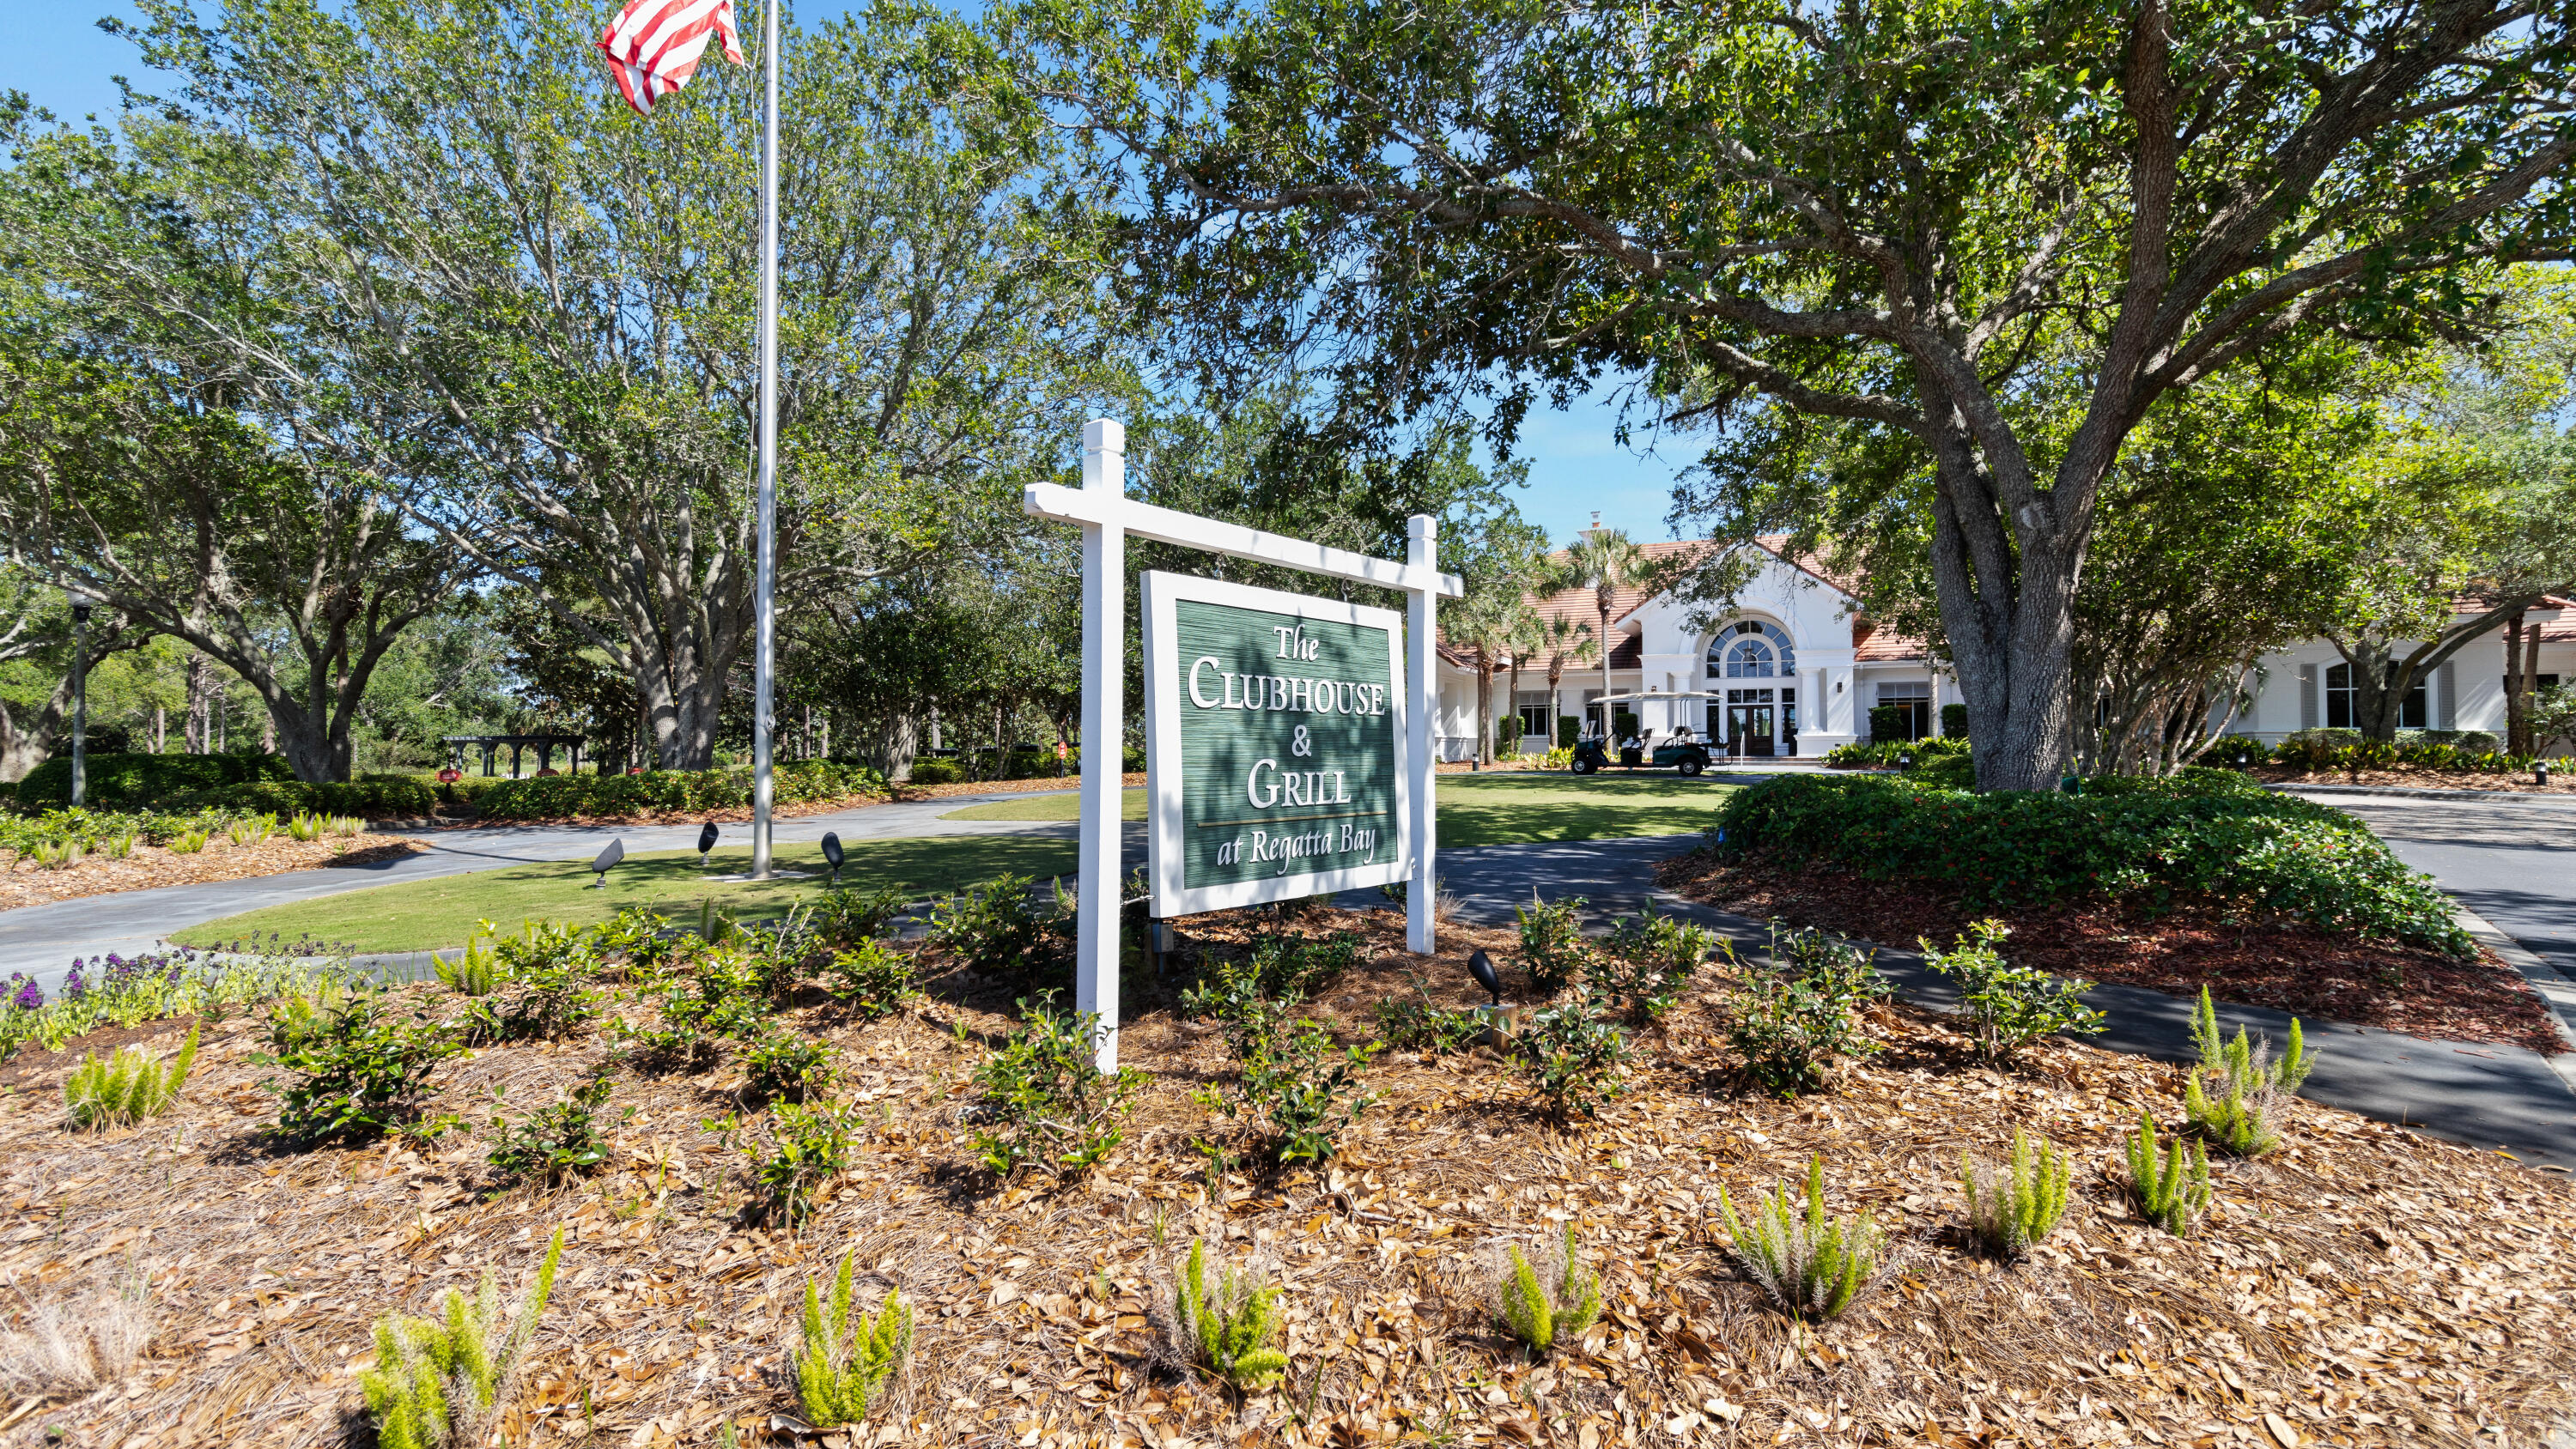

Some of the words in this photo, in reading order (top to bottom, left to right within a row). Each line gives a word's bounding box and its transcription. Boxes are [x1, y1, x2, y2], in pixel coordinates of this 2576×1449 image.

[1273, 623, 1319, 660] The
[1188, 656, 1385, 716] CLUBHOUSE
[1292, 725, 1311, 756] &
[1248, 759, 1352, 809] GRILL
[1217, 834, 1242, 866] at
[1249, 828, 1333, 875] Regatta
[1339, 824, 1376, 864] Bay
